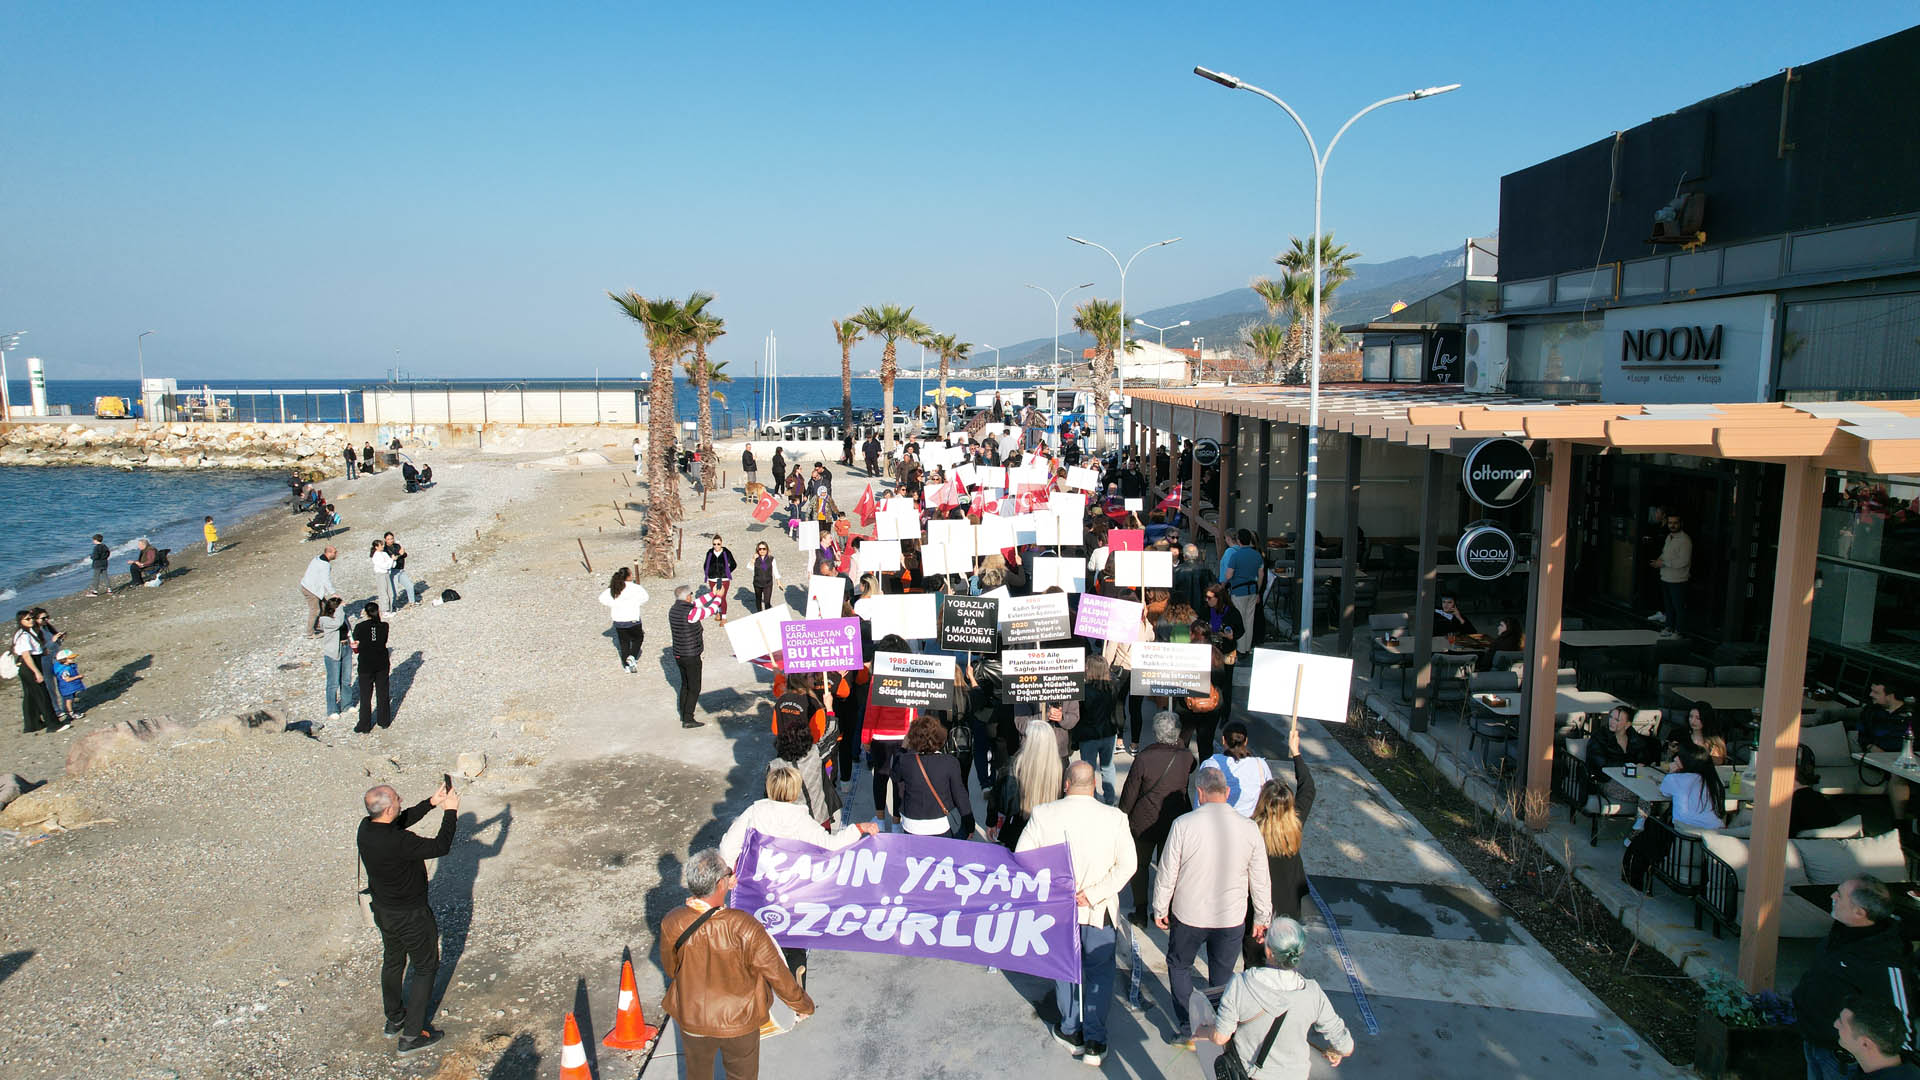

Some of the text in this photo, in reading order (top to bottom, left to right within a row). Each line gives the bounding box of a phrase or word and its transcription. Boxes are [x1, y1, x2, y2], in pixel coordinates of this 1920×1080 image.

[1621, 324, 1723, 361] NOOM
[1432, 337, 1458, 371] La
[1472, 464, 1532, 480] ottoman
[1469, 549, 1509, 558] NOOM
[947, 600, 995, 610] YOBAZLAR
[957, 609, 984, 618] SAKIN
[963, 618, 977, 626] HA
[1011, 621, 1029, 629] 2020
[784, 624, 806, 632] GECE
[944, 625, 995, 636] 4 MADDEYE
[785, 630, 841, 639] KARANLIKTAN
[946, 634, 992, 644] DOKUNMA
[786, 638, 835, 647] KORKARSAN
[787, 641, 854, 659] BU KENTİ
[788, 657, 855, 670] ATEŞE VERİRİZ
[889, 657, 908, 665] 1985
[1009, 658, 1046, 666] Planlaması
[892, 664, 935, 674] İmzalanması
[1014, 665, 1038, 673] Sağlığı
[882, 677, 945, 690] 2021 İstanbul
[1018, 674, 1069, 683] 2019 Kadının
[1010, 680, 1077, 690] Bedenine Müdahale
[878, 686, 947, 699] Sözleşmesi'nden
[1016, 688, 1041, 697] Doğum
[1041, 686, 1080, 695] Kontrolüne
[1151, 687, 1190, 695] vazgeçildi.
[894, 697, 930, 706] vazgeçme
[1015, 693, 1072, 703] Erişim Zorlukları
[753, 847, 1051, 905] KADIN YAŞAM
[753, 892, 1056, 957] ÖZGÜRLÜK
